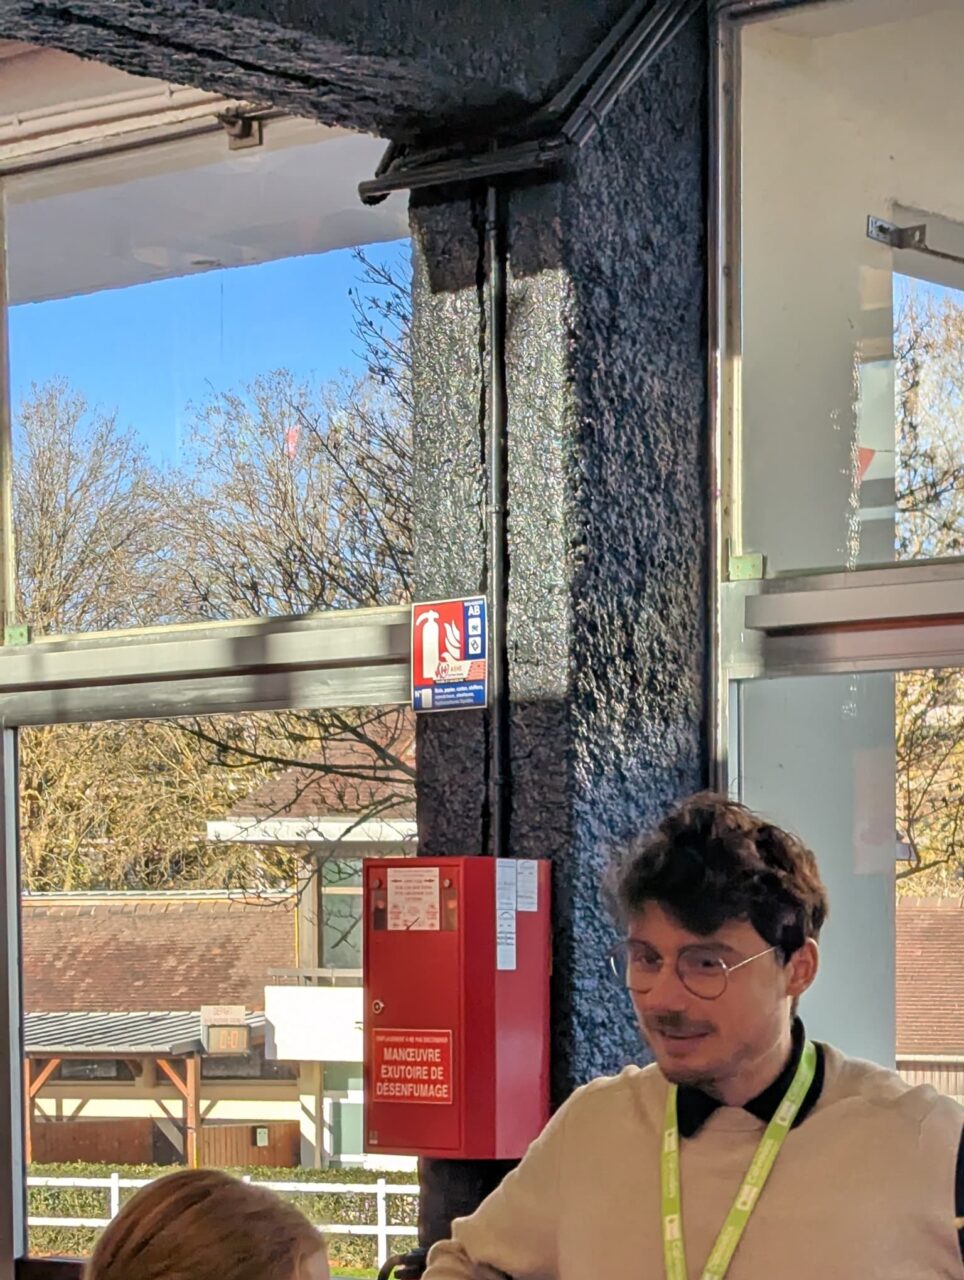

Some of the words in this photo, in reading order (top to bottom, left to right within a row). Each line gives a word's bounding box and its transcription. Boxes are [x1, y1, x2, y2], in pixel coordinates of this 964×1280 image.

[468, 605, 481, 616] AB
[383, 1047, 441, 1062] MANŒUVRE
[381, 1064, 429, 1079] EXUTOIRE
[430, 1066, 444, 1080] DE
[376, 1080, 449, 1098] DÉSENFUMAGE
